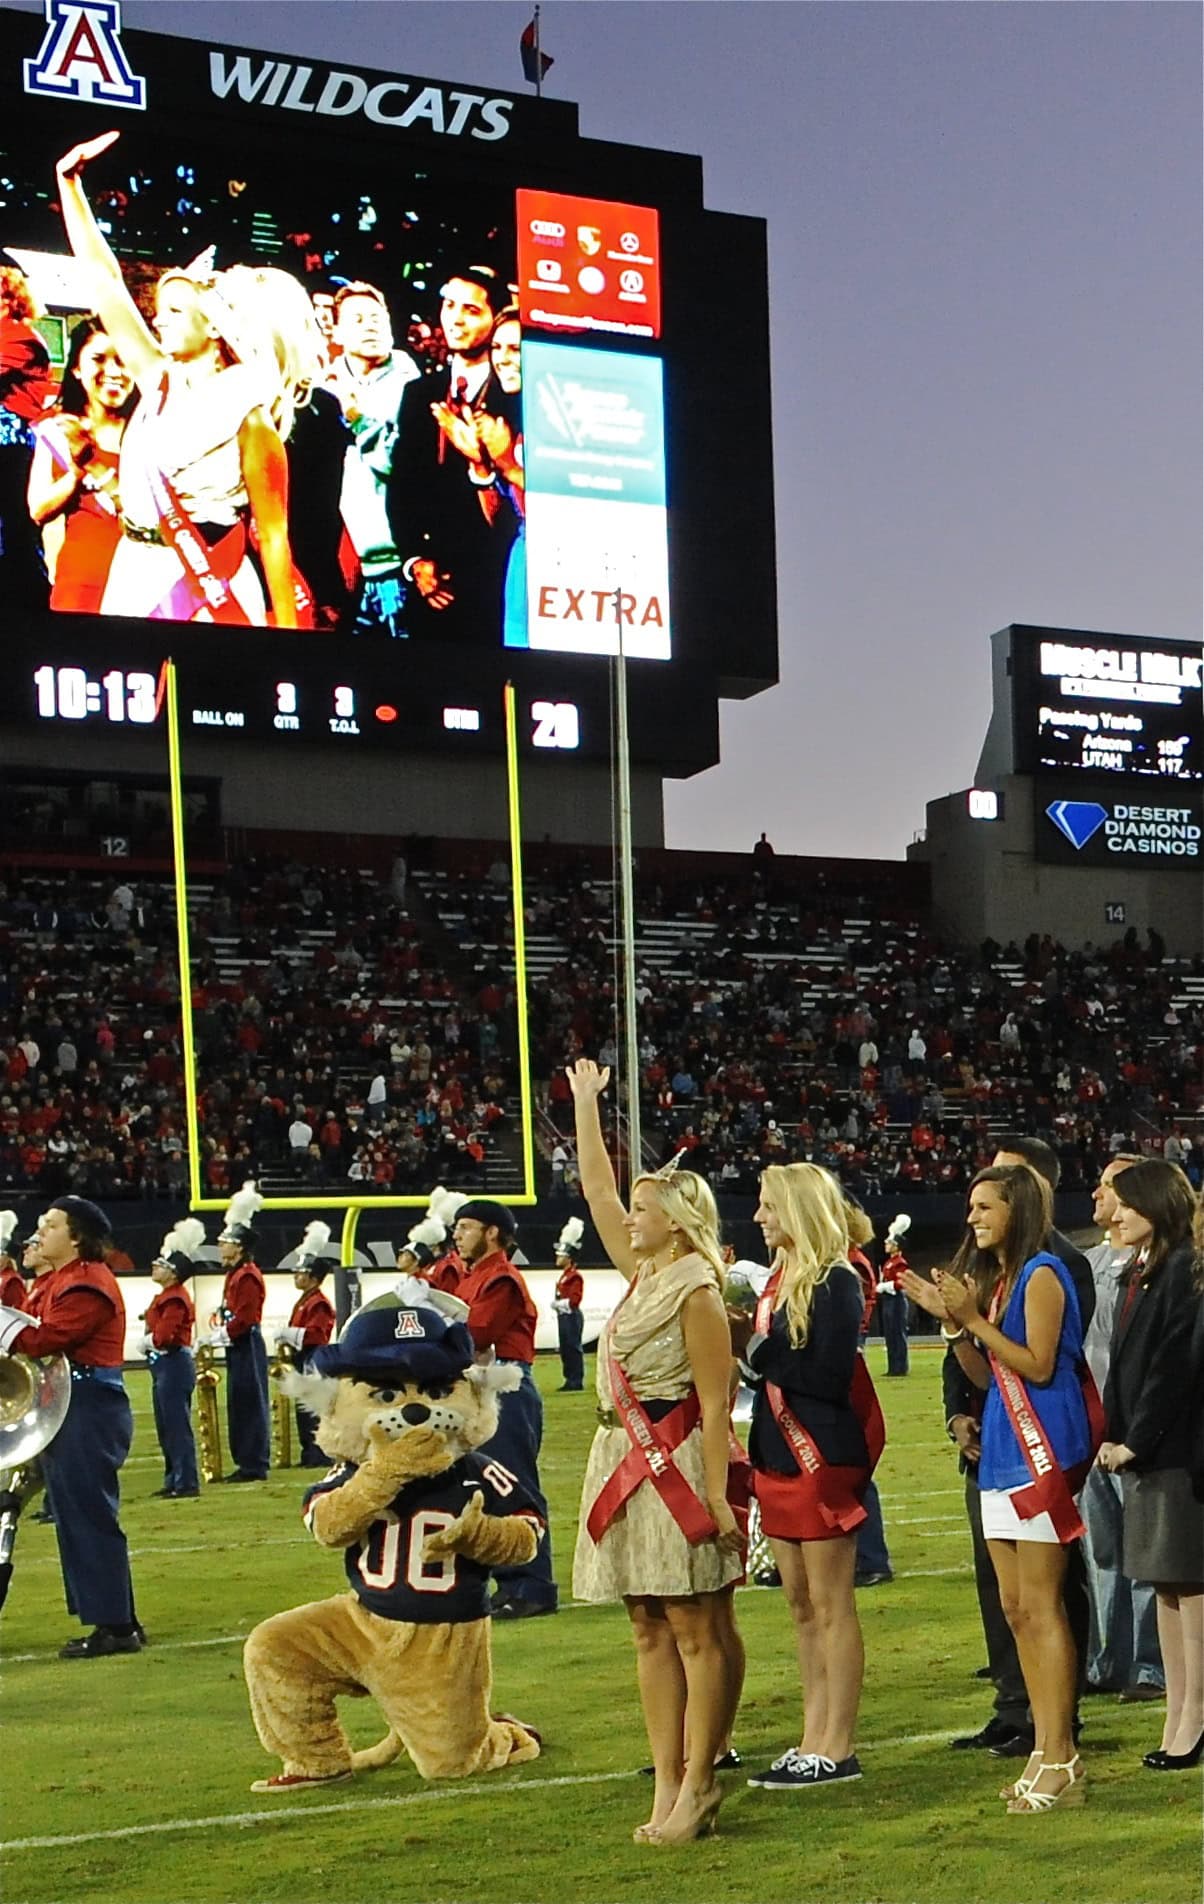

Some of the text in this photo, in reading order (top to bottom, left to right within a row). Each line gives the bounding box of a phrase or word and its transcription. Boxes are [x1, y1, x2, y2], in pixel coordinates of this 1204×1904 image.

[23, 0, 147, 110] A
[209, 51, 514, 141] WILDCATS
[537, 586, 664, 628] EXTRA
[35, 666, 156, 723] 10:13
[193, 710, 244, 726] BALL ON
[1082, 751, 1122, 767] UTAH
[1113, 805, 1191, 822] DESERT
[1104, 821, 1201, 839] DIAMOND
[104, 837, 126, 856] 12
[1107, 837, 1199, 855] CASINOS
[1106, 905, 1124, 921] 14
[395, 1311, 425, 1338] A
[627, 1408, 653, 1446] QUEEN
[778, 1412, 821, 1475] COURT 2011
[1016, 1411, 1041, 1447] COURT
[1029, 1445, 1053, 1476] 2011
